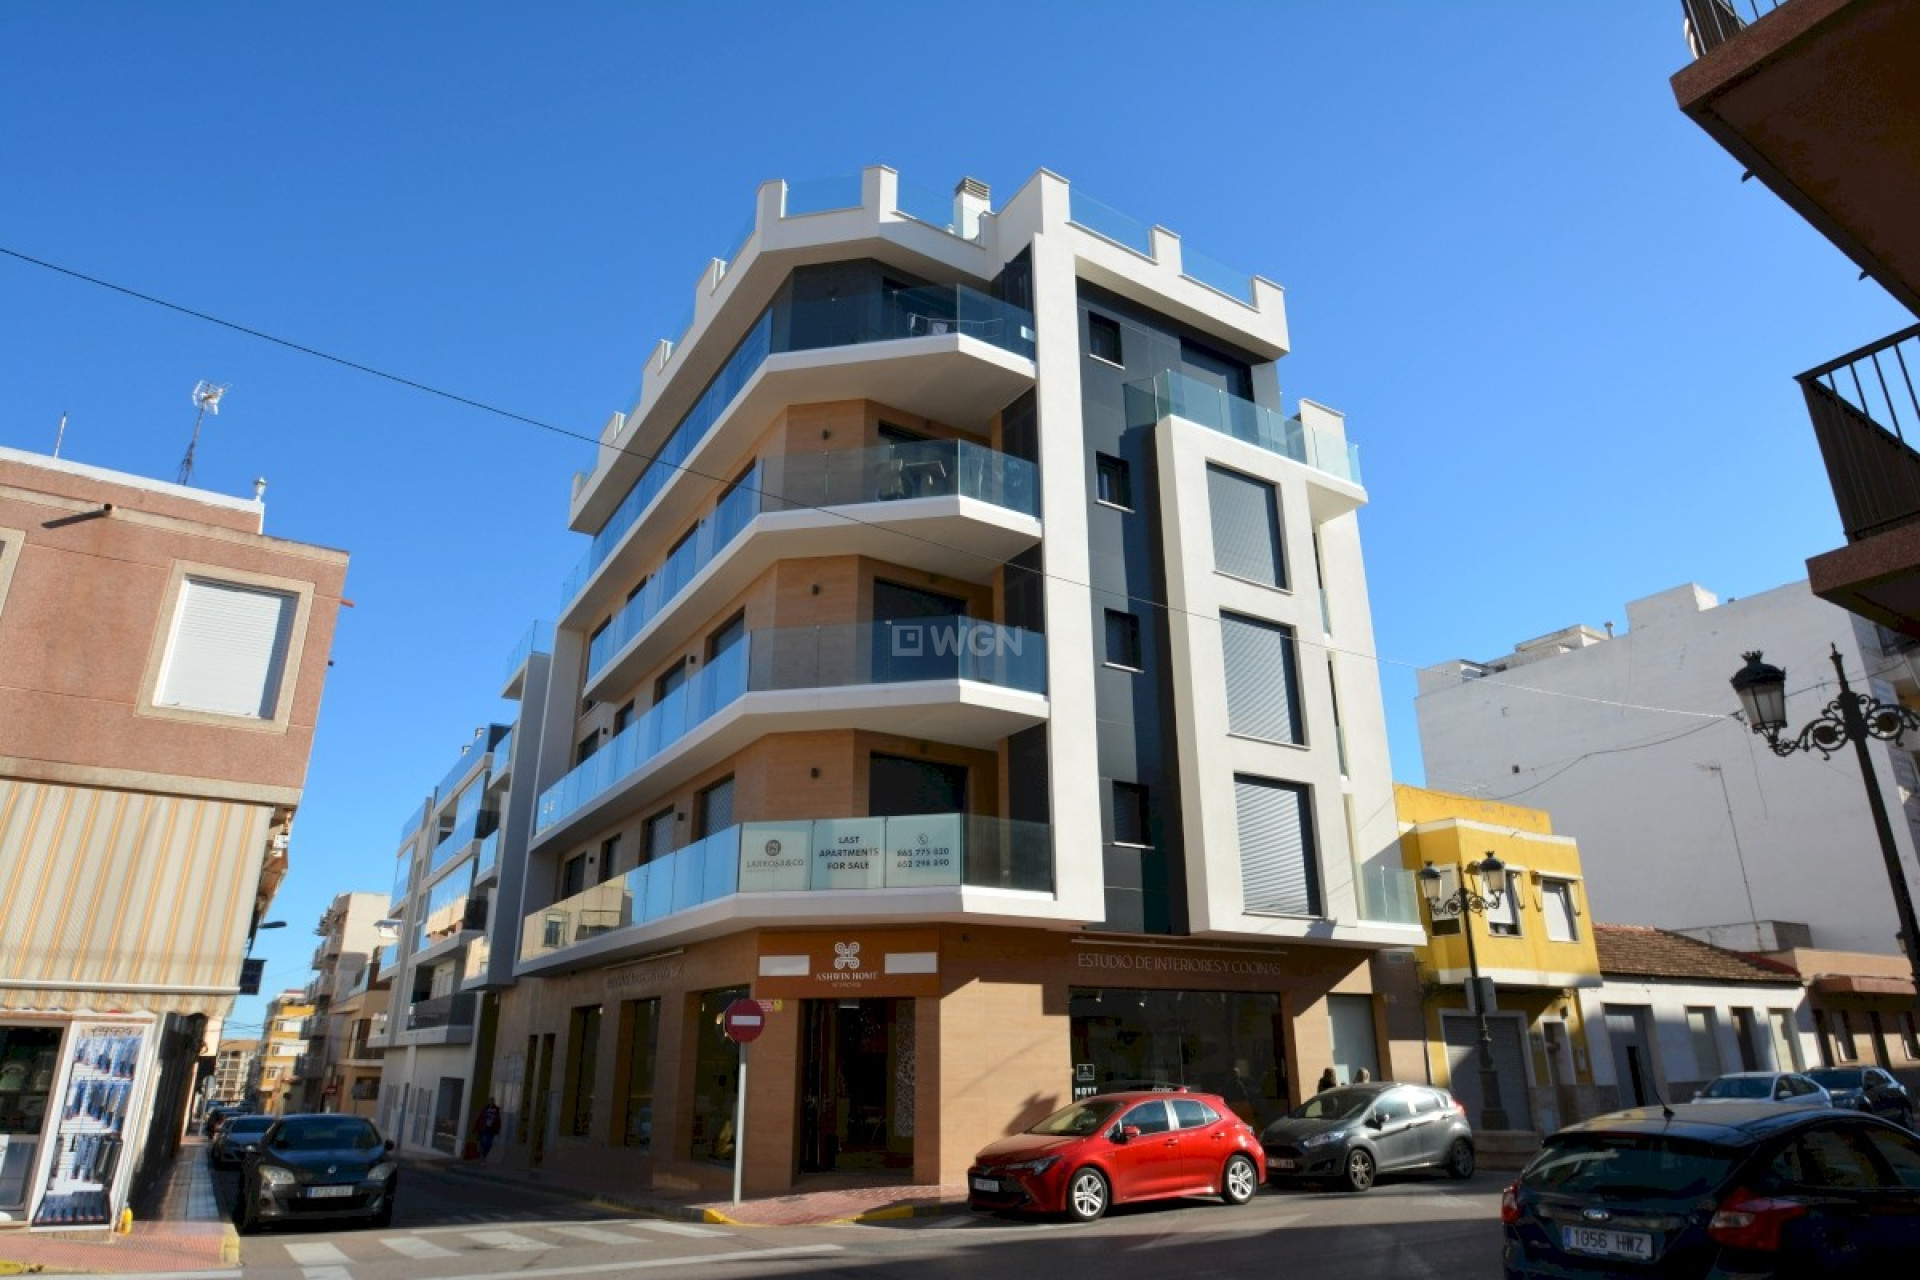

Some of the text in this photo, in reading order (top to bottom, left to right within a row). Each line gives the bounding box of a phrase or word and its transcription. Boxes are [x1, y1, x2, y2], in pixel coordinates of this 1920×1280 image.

[838, 836, 860, 844] LAST
[818, 848, 880, 857] APARTMENTS
[826, 861, 870, 870] FOR SALE
[1077, 953, 1133, 969] ESTUDIO
[1135, 956, 1153, 970] DE
[1154, 956, 1221, 974] INTERIORES
[1220, 960, 1231, 974] Y
[852, 971, 878, 981] HOME
[1574, 1229, 1608, 1249] 1056
